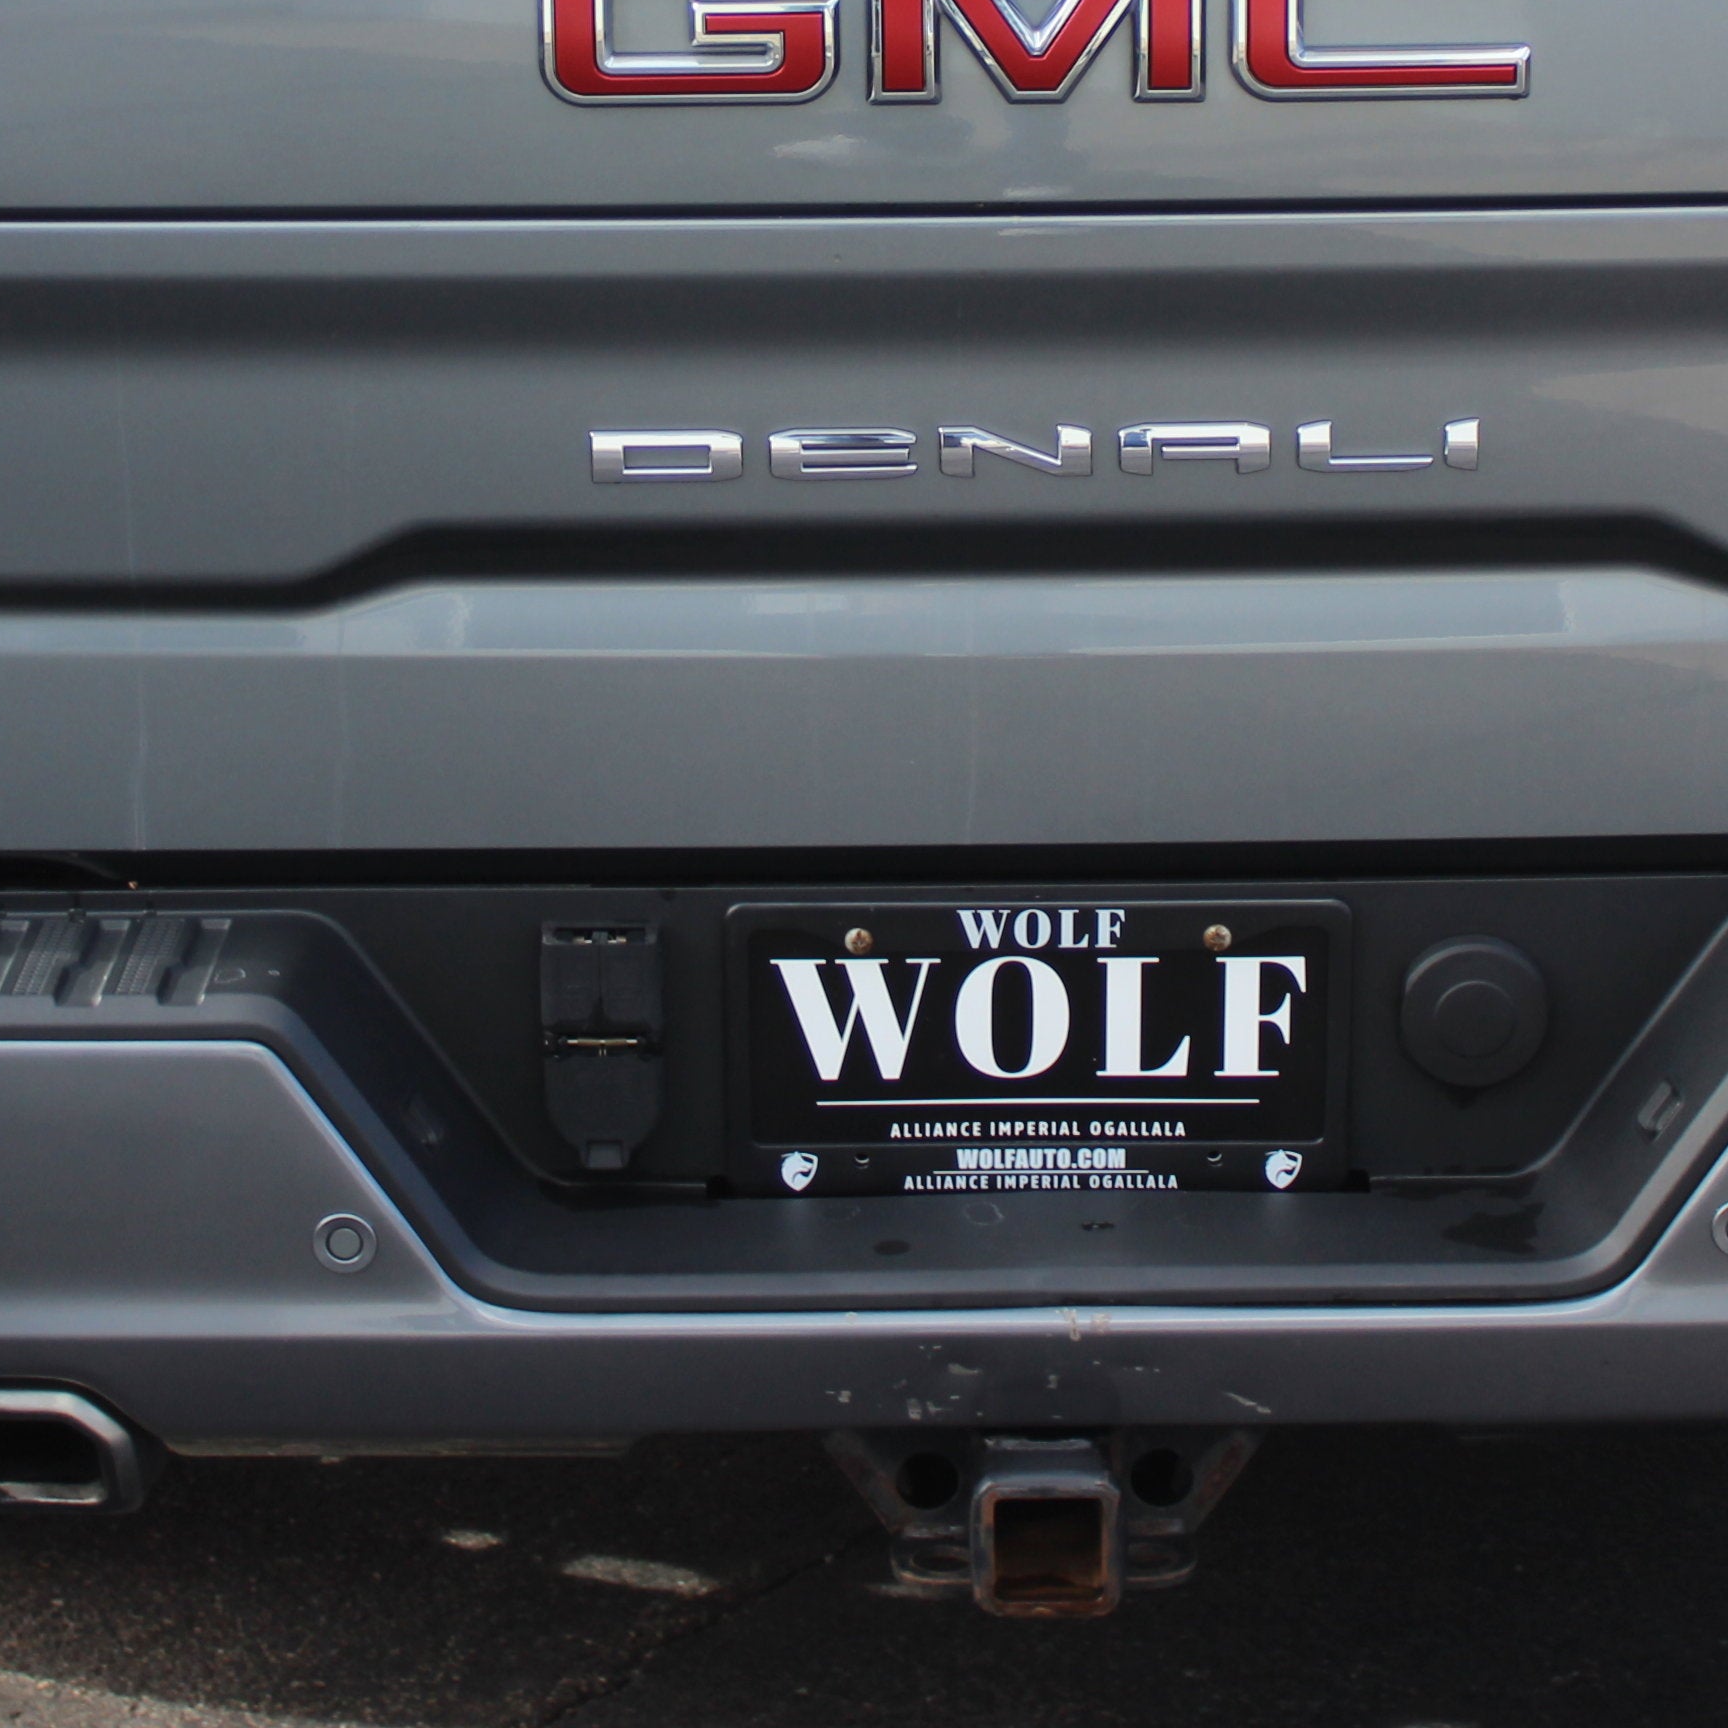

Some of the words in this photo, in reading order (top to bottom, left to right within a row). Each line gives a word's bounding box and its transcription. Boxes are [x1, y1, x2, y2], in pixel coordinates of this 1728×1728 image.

[589, 418, 1480, 484] DENALI
[957, 908, 1127, 949] WOLF
[770, 955, 1308, 1081] WOLF
[890, 1122, 982, 1139] ALLIANCE
[990, 1121, 1081, 1137] IMPERIAL
[1089, 1121, 1186, 1138] OGALLALA
[956, 1148, 1127, 1170] WOLFAUTO.COM
[903, 1174, 989, 1191] ALLIANCE
[996, 1175, 1081, 1190] IMPERIAL
[1089, 1175, 1178, 1190] OGALLALA
